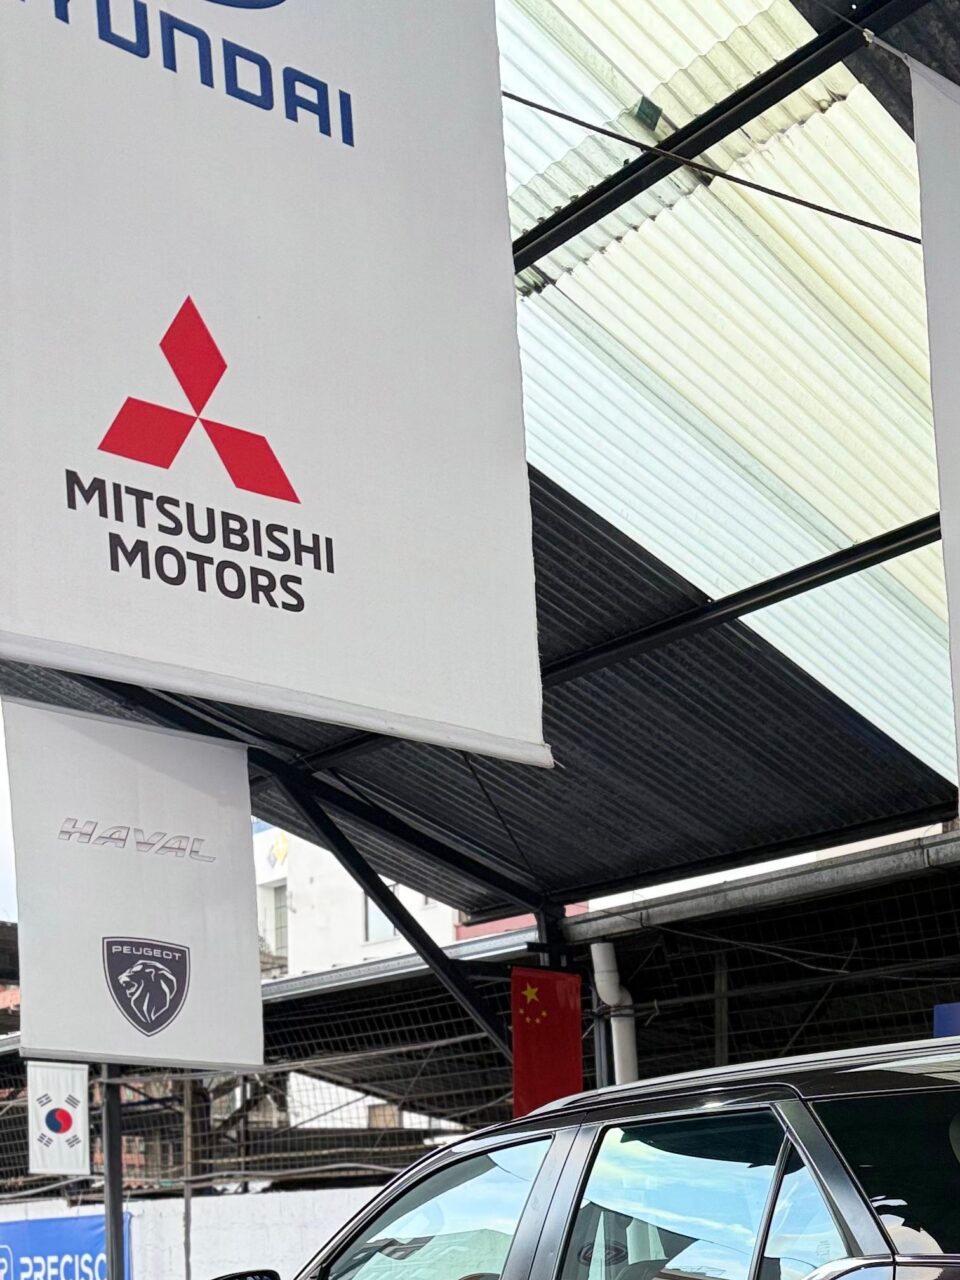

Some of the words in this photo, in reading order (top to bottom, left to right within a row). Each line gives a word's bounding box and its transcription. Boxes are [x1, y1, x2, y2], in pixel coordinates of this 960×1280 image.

[19, 0, 354, 147] UNDAI
[65, 468, 335, 574] MITSUBISHI
[109, 532, 305, 613] MOTORS
[57, 818, 216, 862] HAVAL
[111, 945, 182, 961] PEUGEOT
